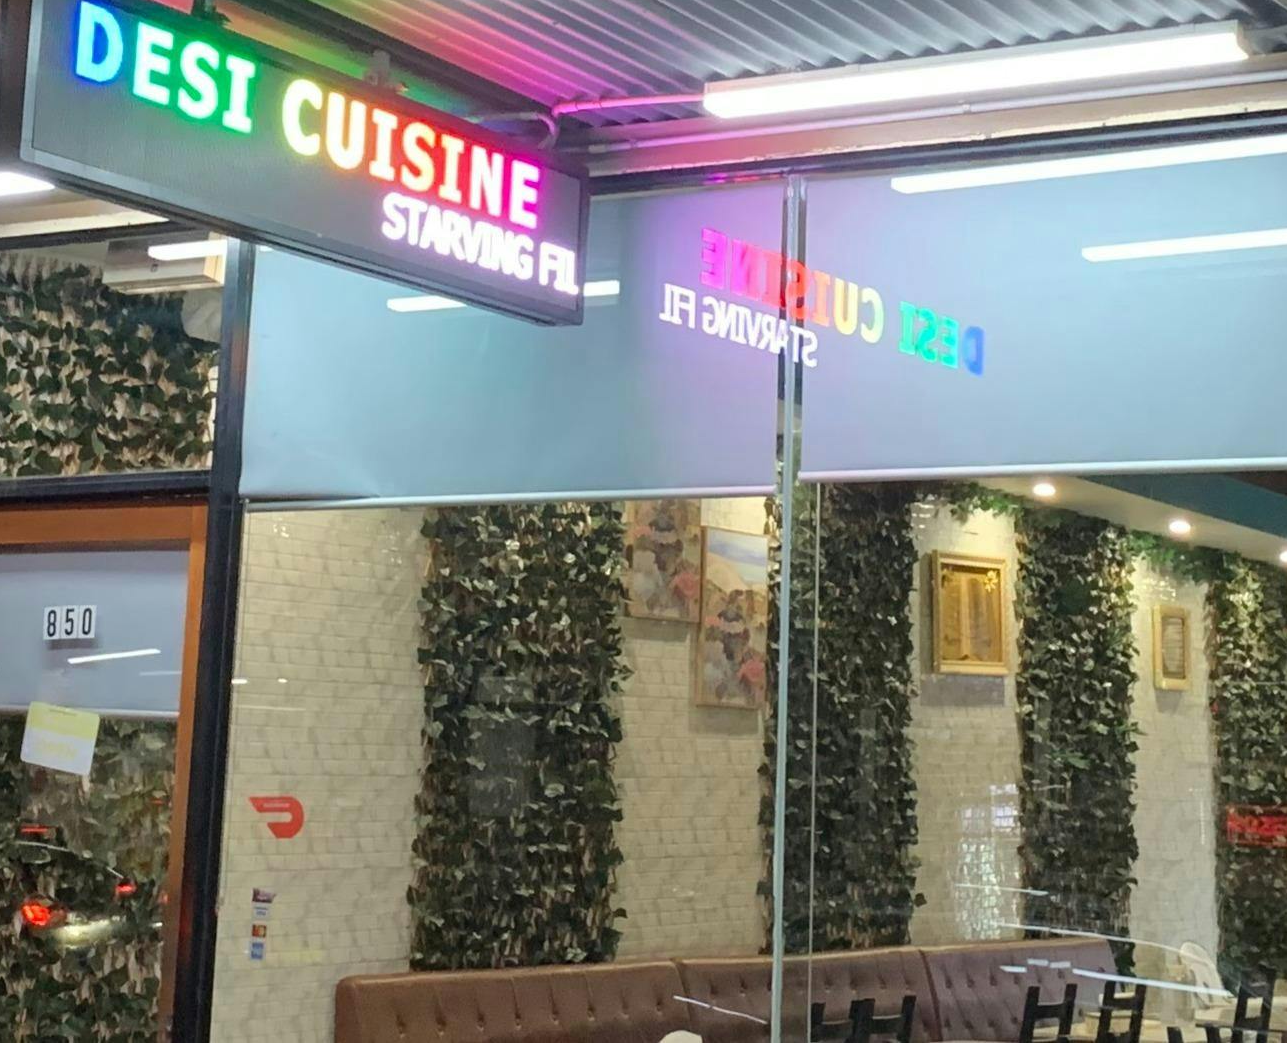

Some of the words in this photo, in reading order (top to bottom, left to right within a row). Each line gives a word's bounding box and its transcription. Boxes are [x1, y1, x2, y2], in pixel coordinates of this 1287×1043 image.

[75, 0, 257, 133] DESI
[281, 79, 541, 228] CUISINE
[381, 192, 534, 280] STARVING
[47, 608, 93, 637] 850
